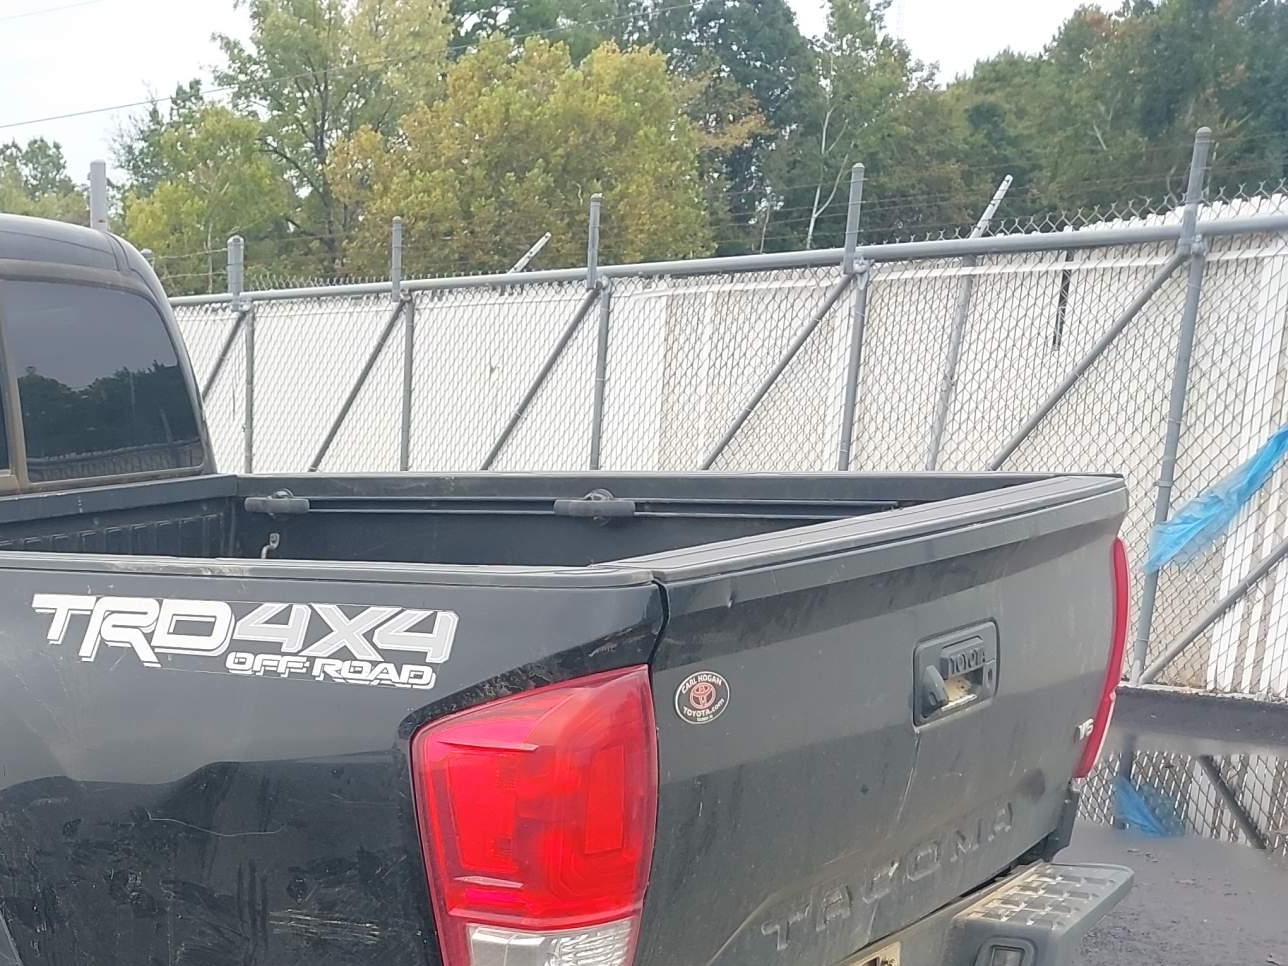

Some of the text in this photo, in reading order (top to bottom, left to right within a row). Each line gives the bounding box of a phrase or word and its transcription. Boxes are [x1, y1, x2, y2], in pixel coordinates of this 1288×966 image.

[225, 651, 436, 690] OFF ROAD
[946, 645, 986, 676] TOYOTA
[681, 674, 722, 694] CARL HOGAN
[761, 801, 1013, 951] TACOMA
